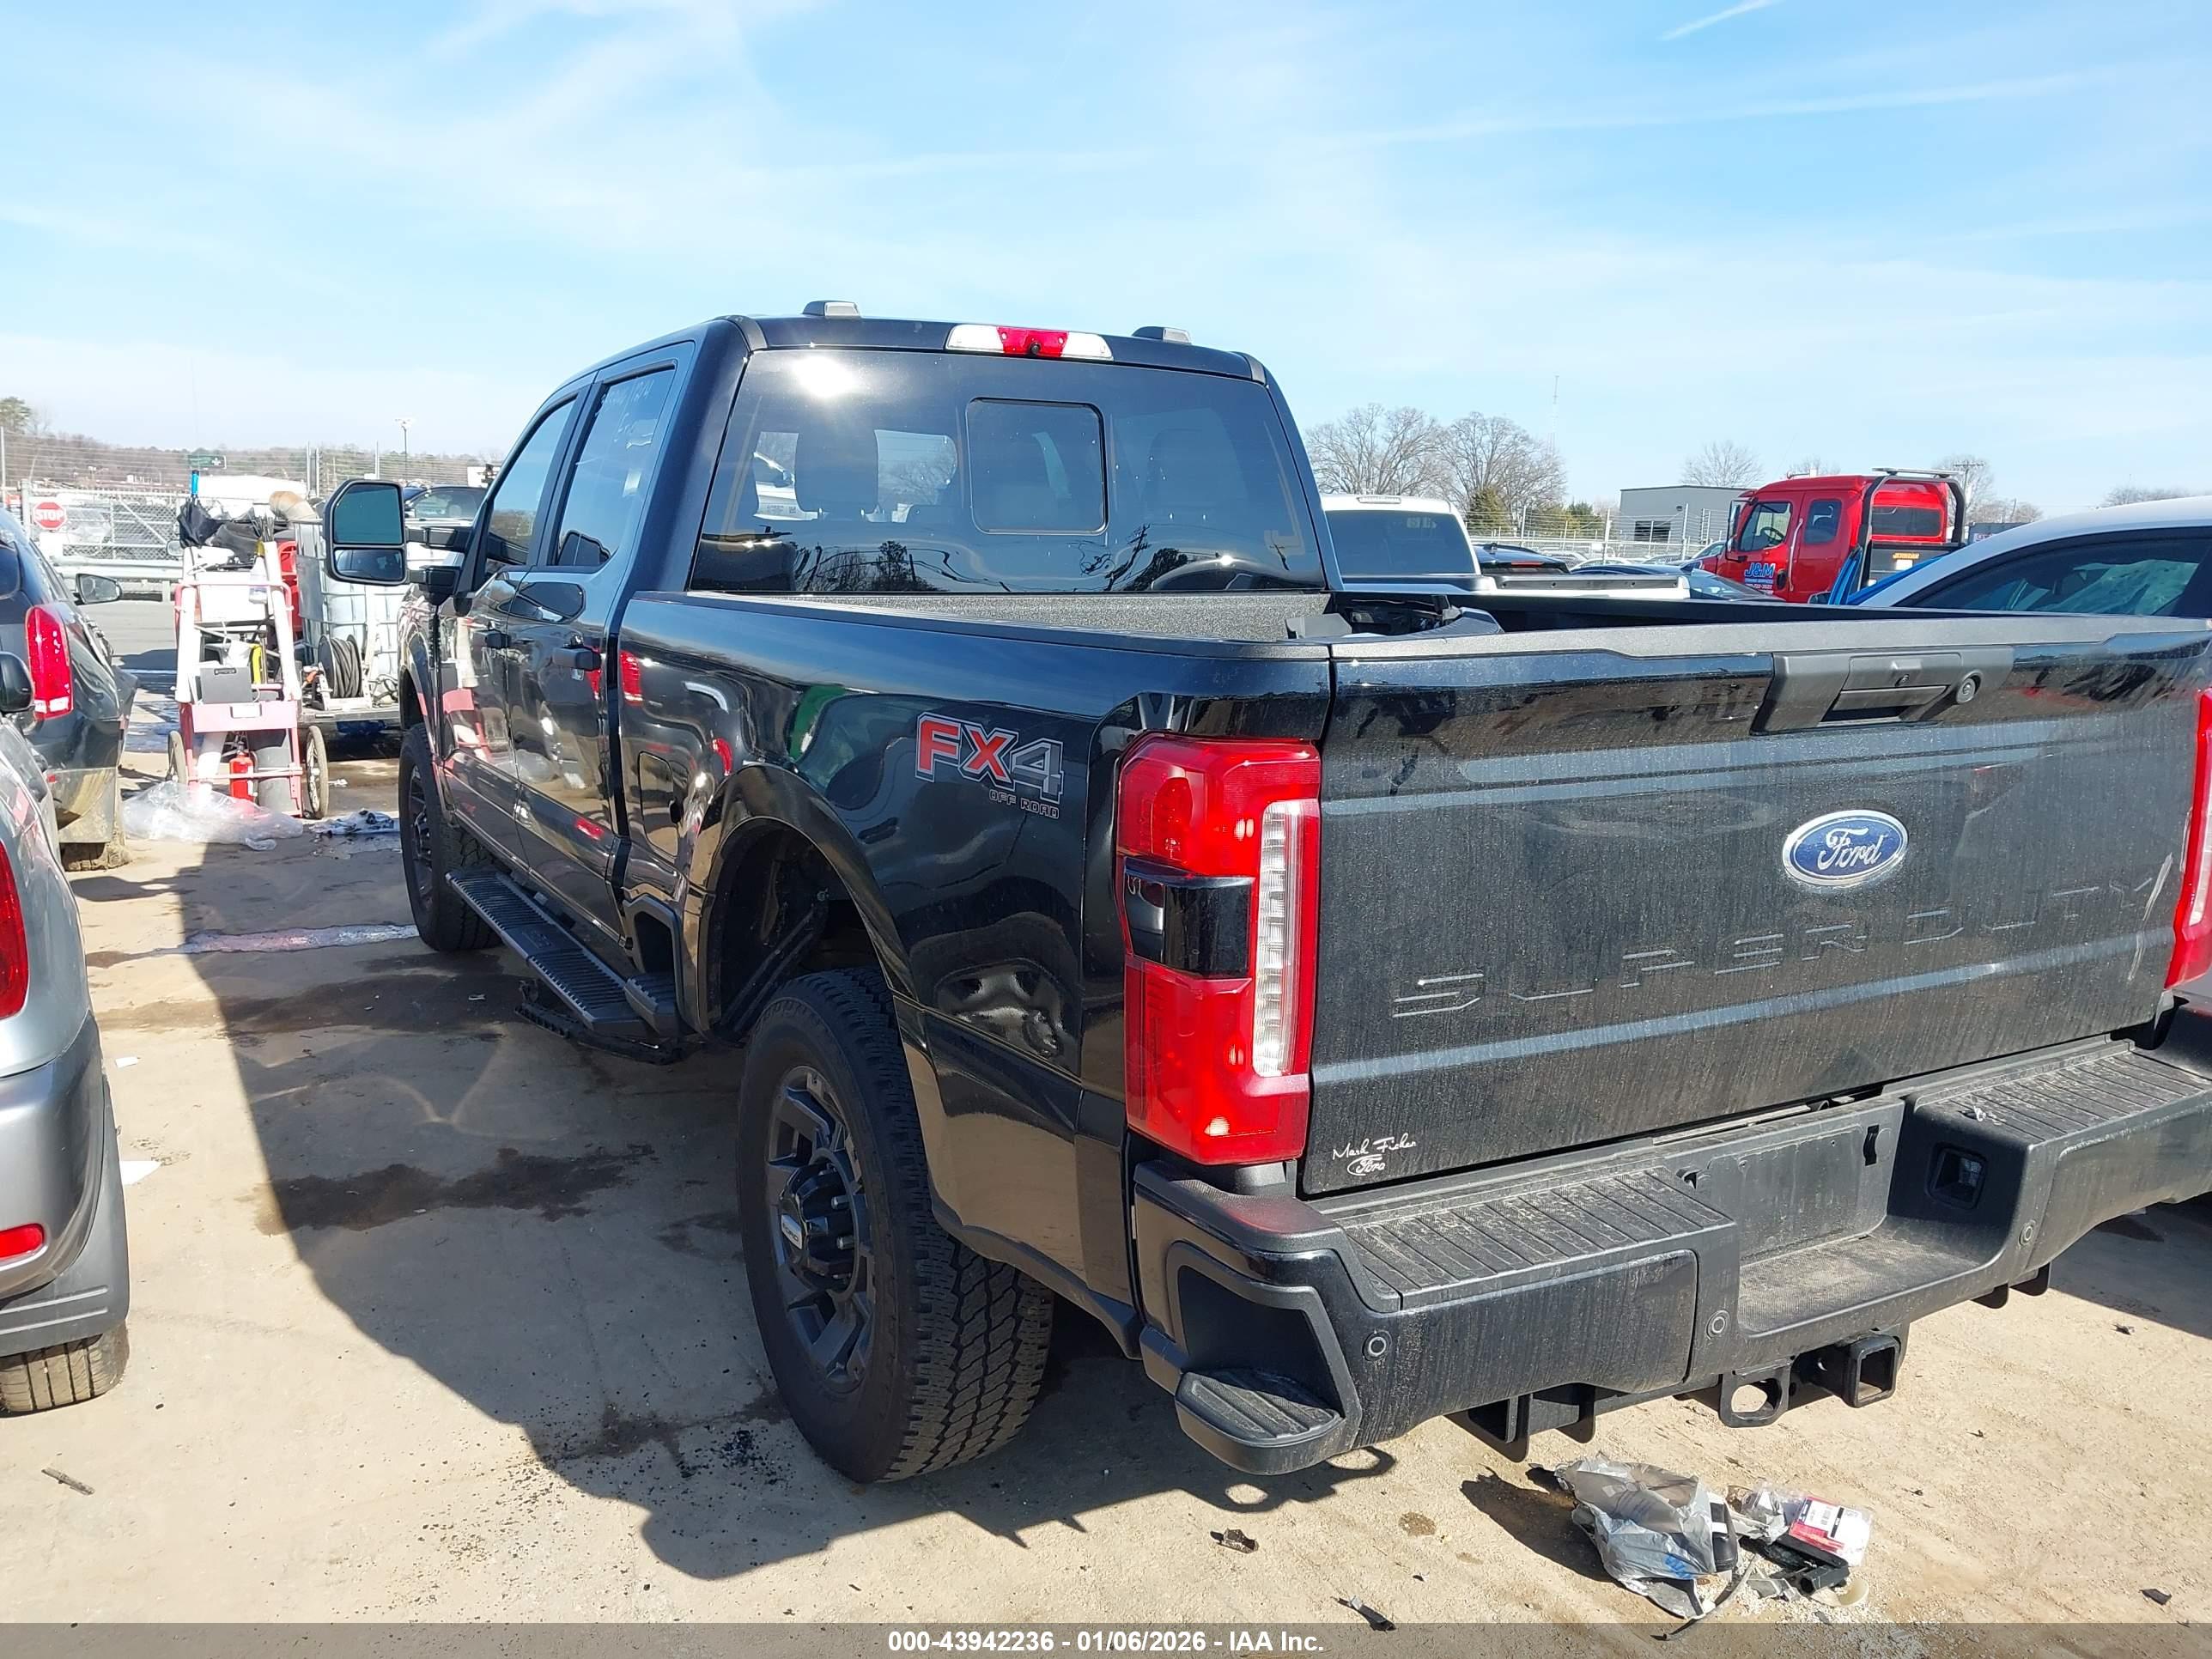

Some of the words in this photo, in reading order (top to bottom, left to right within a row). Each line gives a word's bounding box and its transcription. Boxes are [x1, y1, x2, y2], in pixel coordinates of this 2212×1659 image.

[35, 509, 65, 520] STOP
[1744, 562, 1776, 578] J&M
[915, 712, 1064, 804] FX4
[989, 789, 1017, 805] OFF
[1020, 798, 1060, 818] ROAD
[1816, 827, 1885, 871] Ford
[1391, 921, 1867, 1018] SUPER
